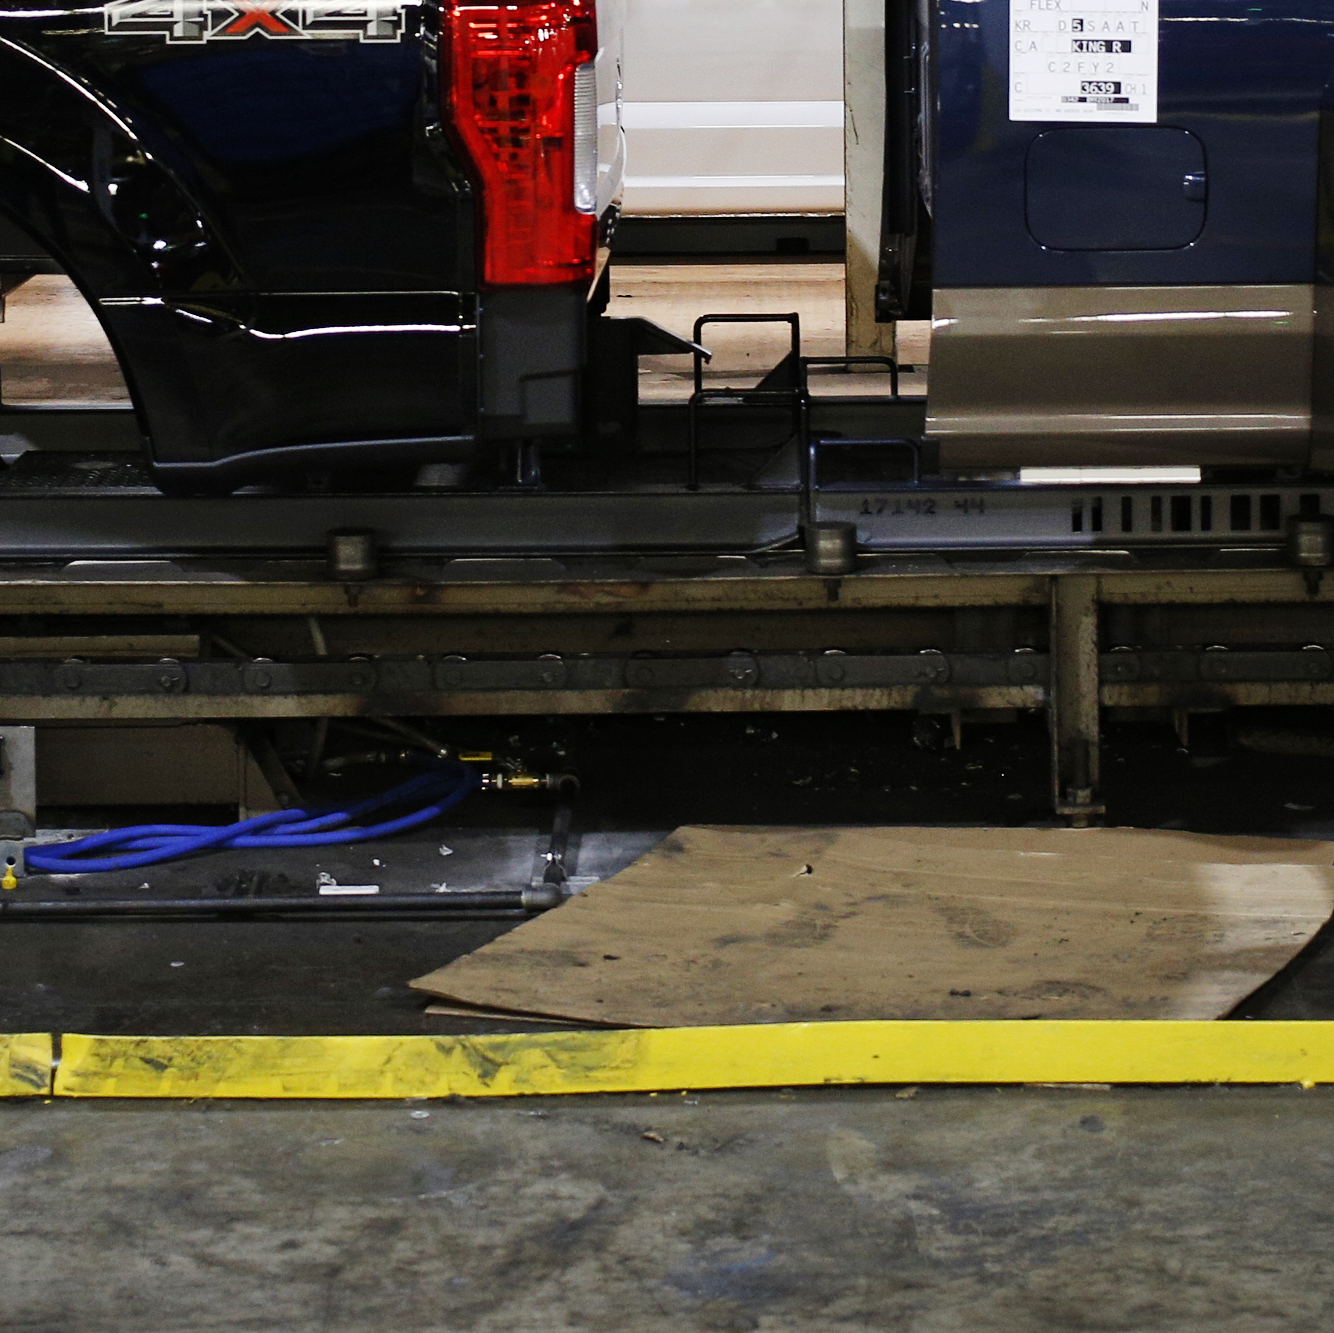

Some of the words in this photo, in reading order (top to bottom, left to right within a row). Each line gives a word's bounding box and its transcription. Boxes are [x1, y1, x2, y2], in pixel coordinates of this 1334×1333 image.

[1030, 0, 1062, 11] FLEX
[1141, 1, 1149, 11] N
[1015, 20, 1031, 31] KR
[1058, 21, 1067, 31] D
[1072, 19, 1082, 32] 5
[1087, 21, 1095, 32] S
[1102, 21, 1110, 32] A
[1116, 21, 1125, 32] A
[1131, 21, 1139, 32] T
[1014, 40, 1022, 52] C
[1029, 41, 1038, 52] A
[1072, 40, 1106, 53] KING
[1112, 40, 1122, 53] R
[1048, 61, 1056, 73] C
[1063, 61, 1071, 73] 2
[1077, 62, 1085, 73] F
[1092, 62, 1100, 73] Y
[1106, 62, 1114, 73] 2
[1014, 82, 1022, 93] C
[1081, 82, 1115, 94] 3639
